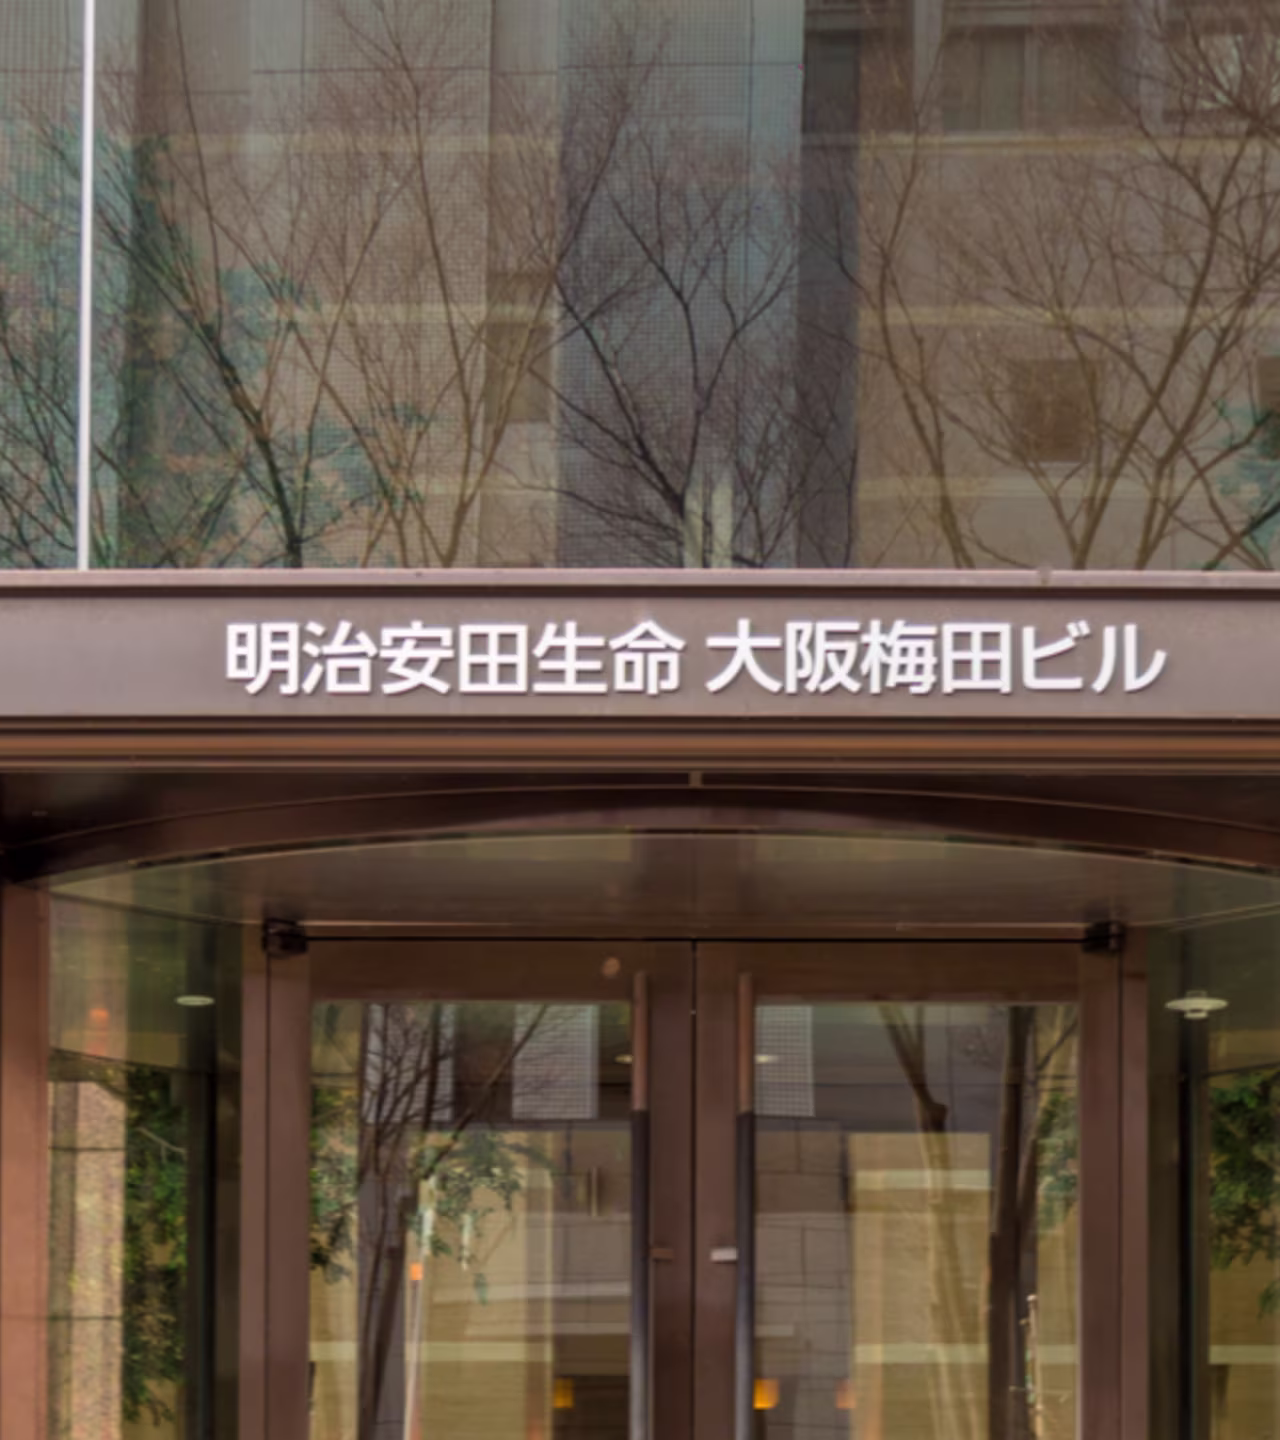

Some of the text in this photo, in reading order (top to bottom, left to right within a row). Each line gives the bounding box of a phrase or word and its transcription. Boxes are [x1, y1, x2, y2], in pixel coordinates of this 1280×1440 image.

[225, 618, 1168, 695] 明治安田生命 大阪梅田ビル
